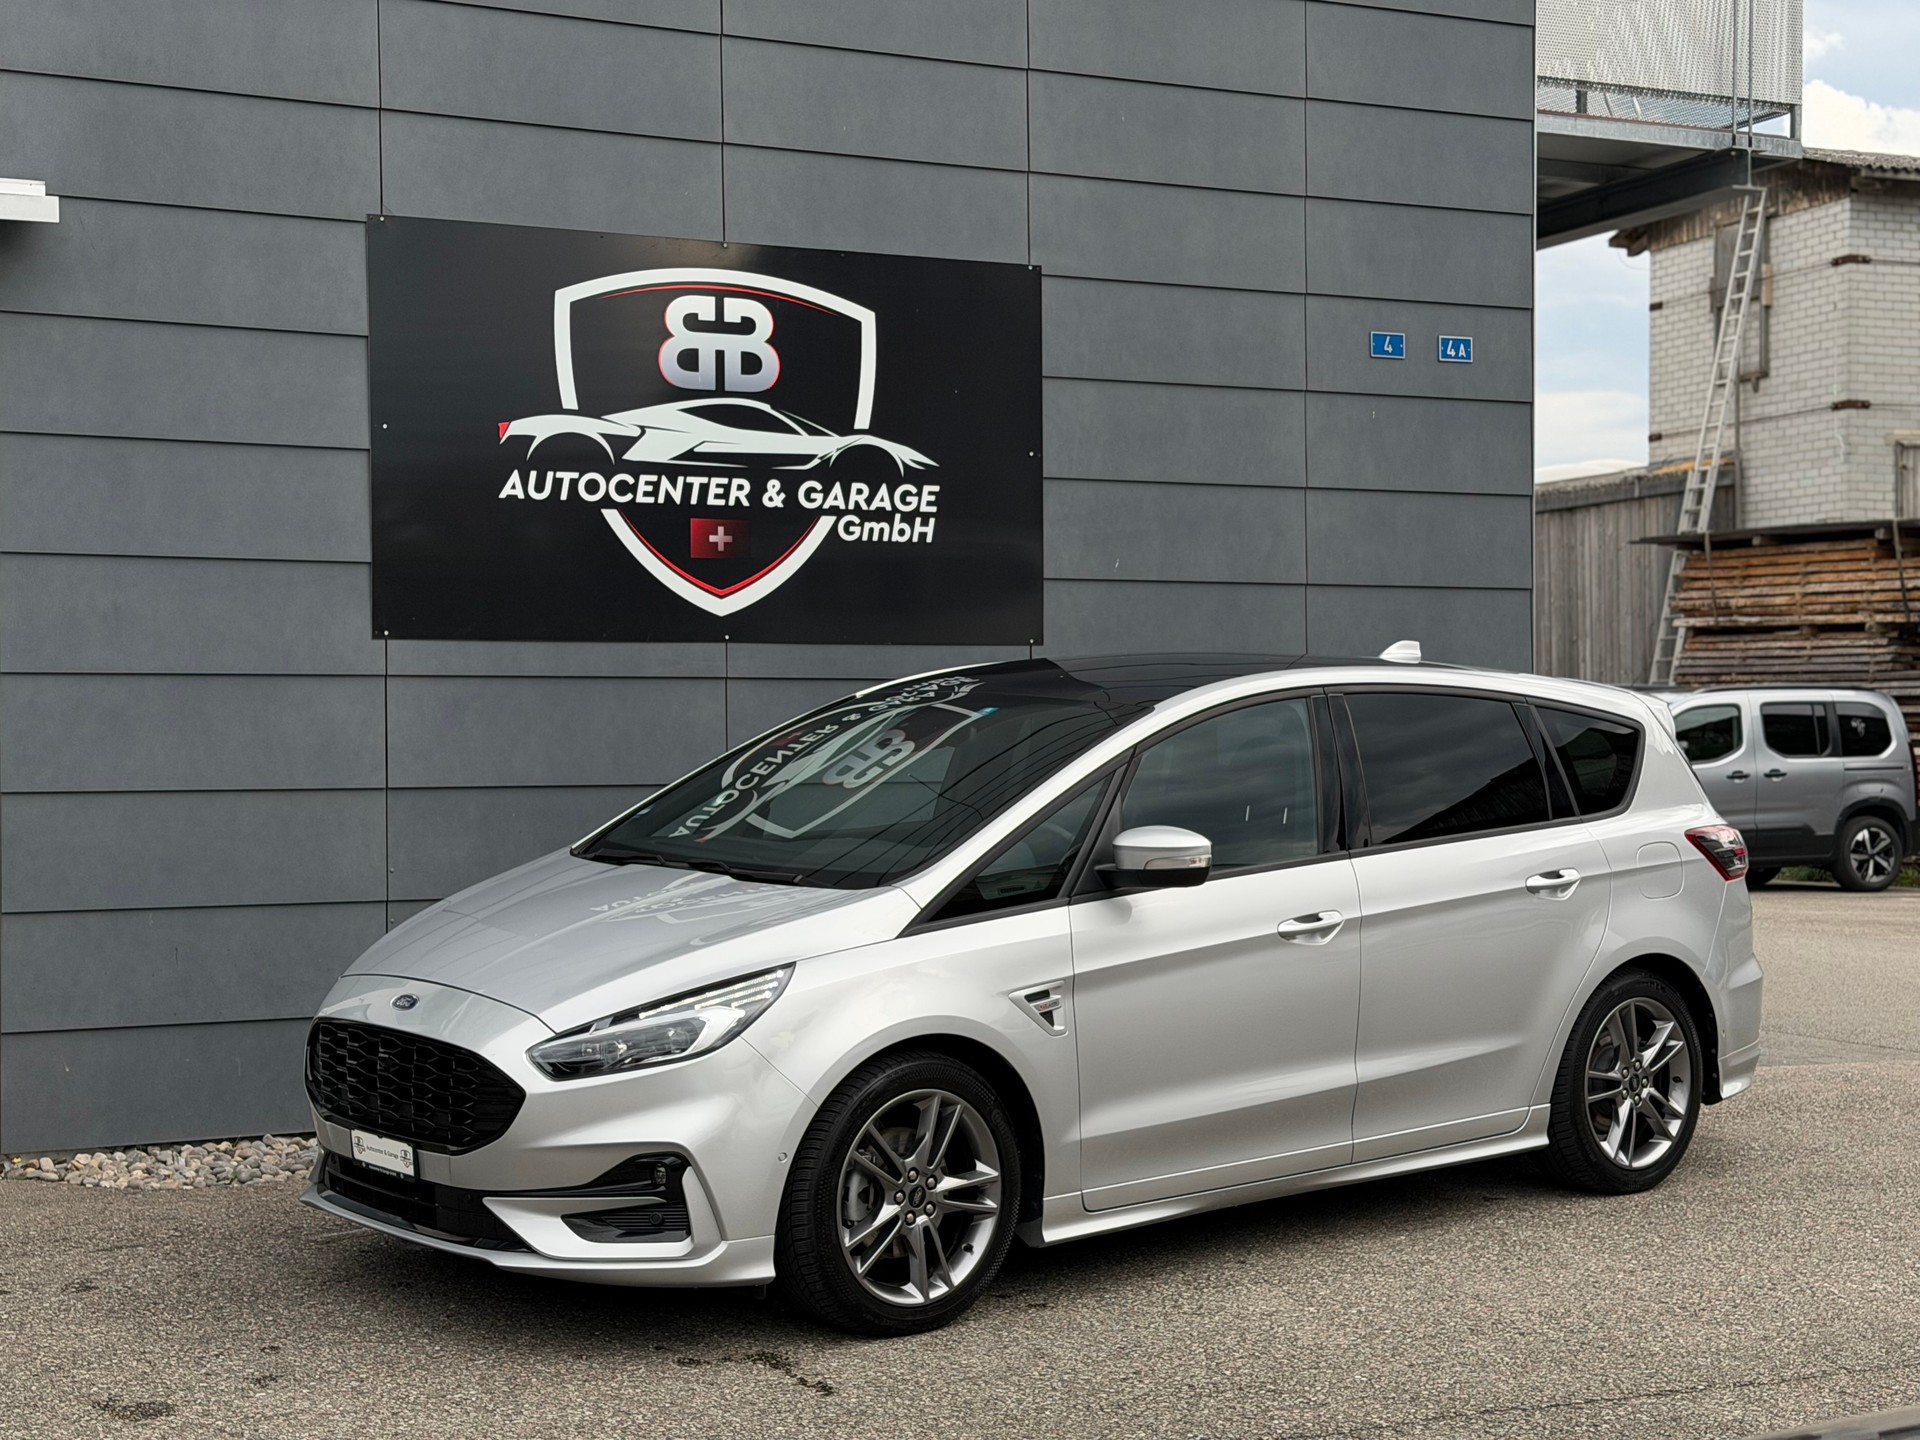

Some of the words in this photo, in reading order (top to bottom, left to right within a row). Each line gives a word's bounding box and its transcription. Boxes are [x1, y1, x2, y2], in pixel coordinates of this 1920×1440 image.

[1383, 335, 1393, 353] 4
[1446, 339, 1467, 358] 4A
[498, 468, 751, 507] AUTOCENTER
[762, 478, 787, 508] &
[797, 480, 941, 513] GARAGE
[837, 512, 936, 544] GmbH
